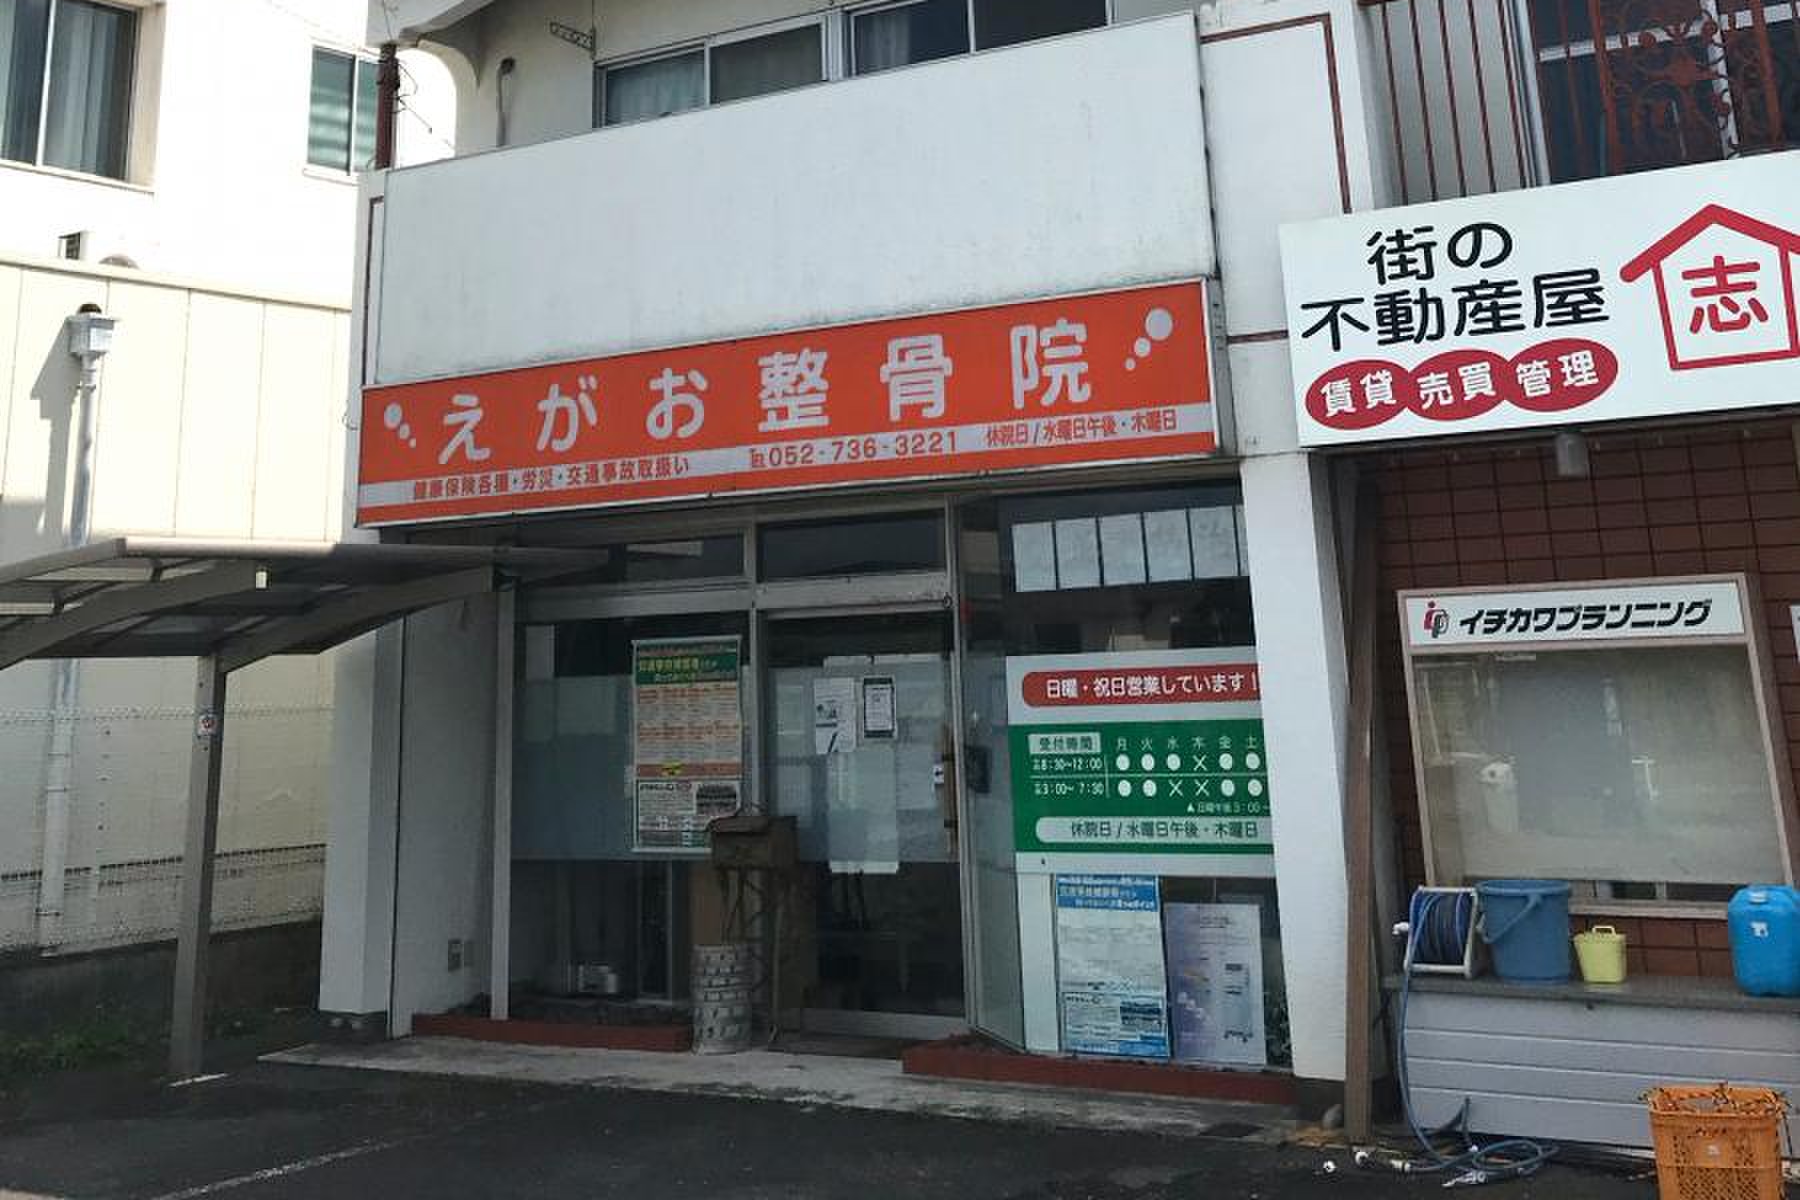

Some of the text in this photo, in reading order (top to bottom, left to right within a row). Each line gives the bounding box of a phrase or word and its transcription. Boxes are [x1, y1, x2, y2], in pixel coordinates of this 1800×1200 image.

[1366, 221, 1513, 285] 街の
[1300, 267, 1609, 351] 不動産屋
[1681, 255, 1768, 334] 志
[438, 317, 1092, 464] えがお整骨院
[1320, 349, 1601, 418] 賃貸 売買 管理
[1459, 599, 1712, 634] イチカワプランニング
